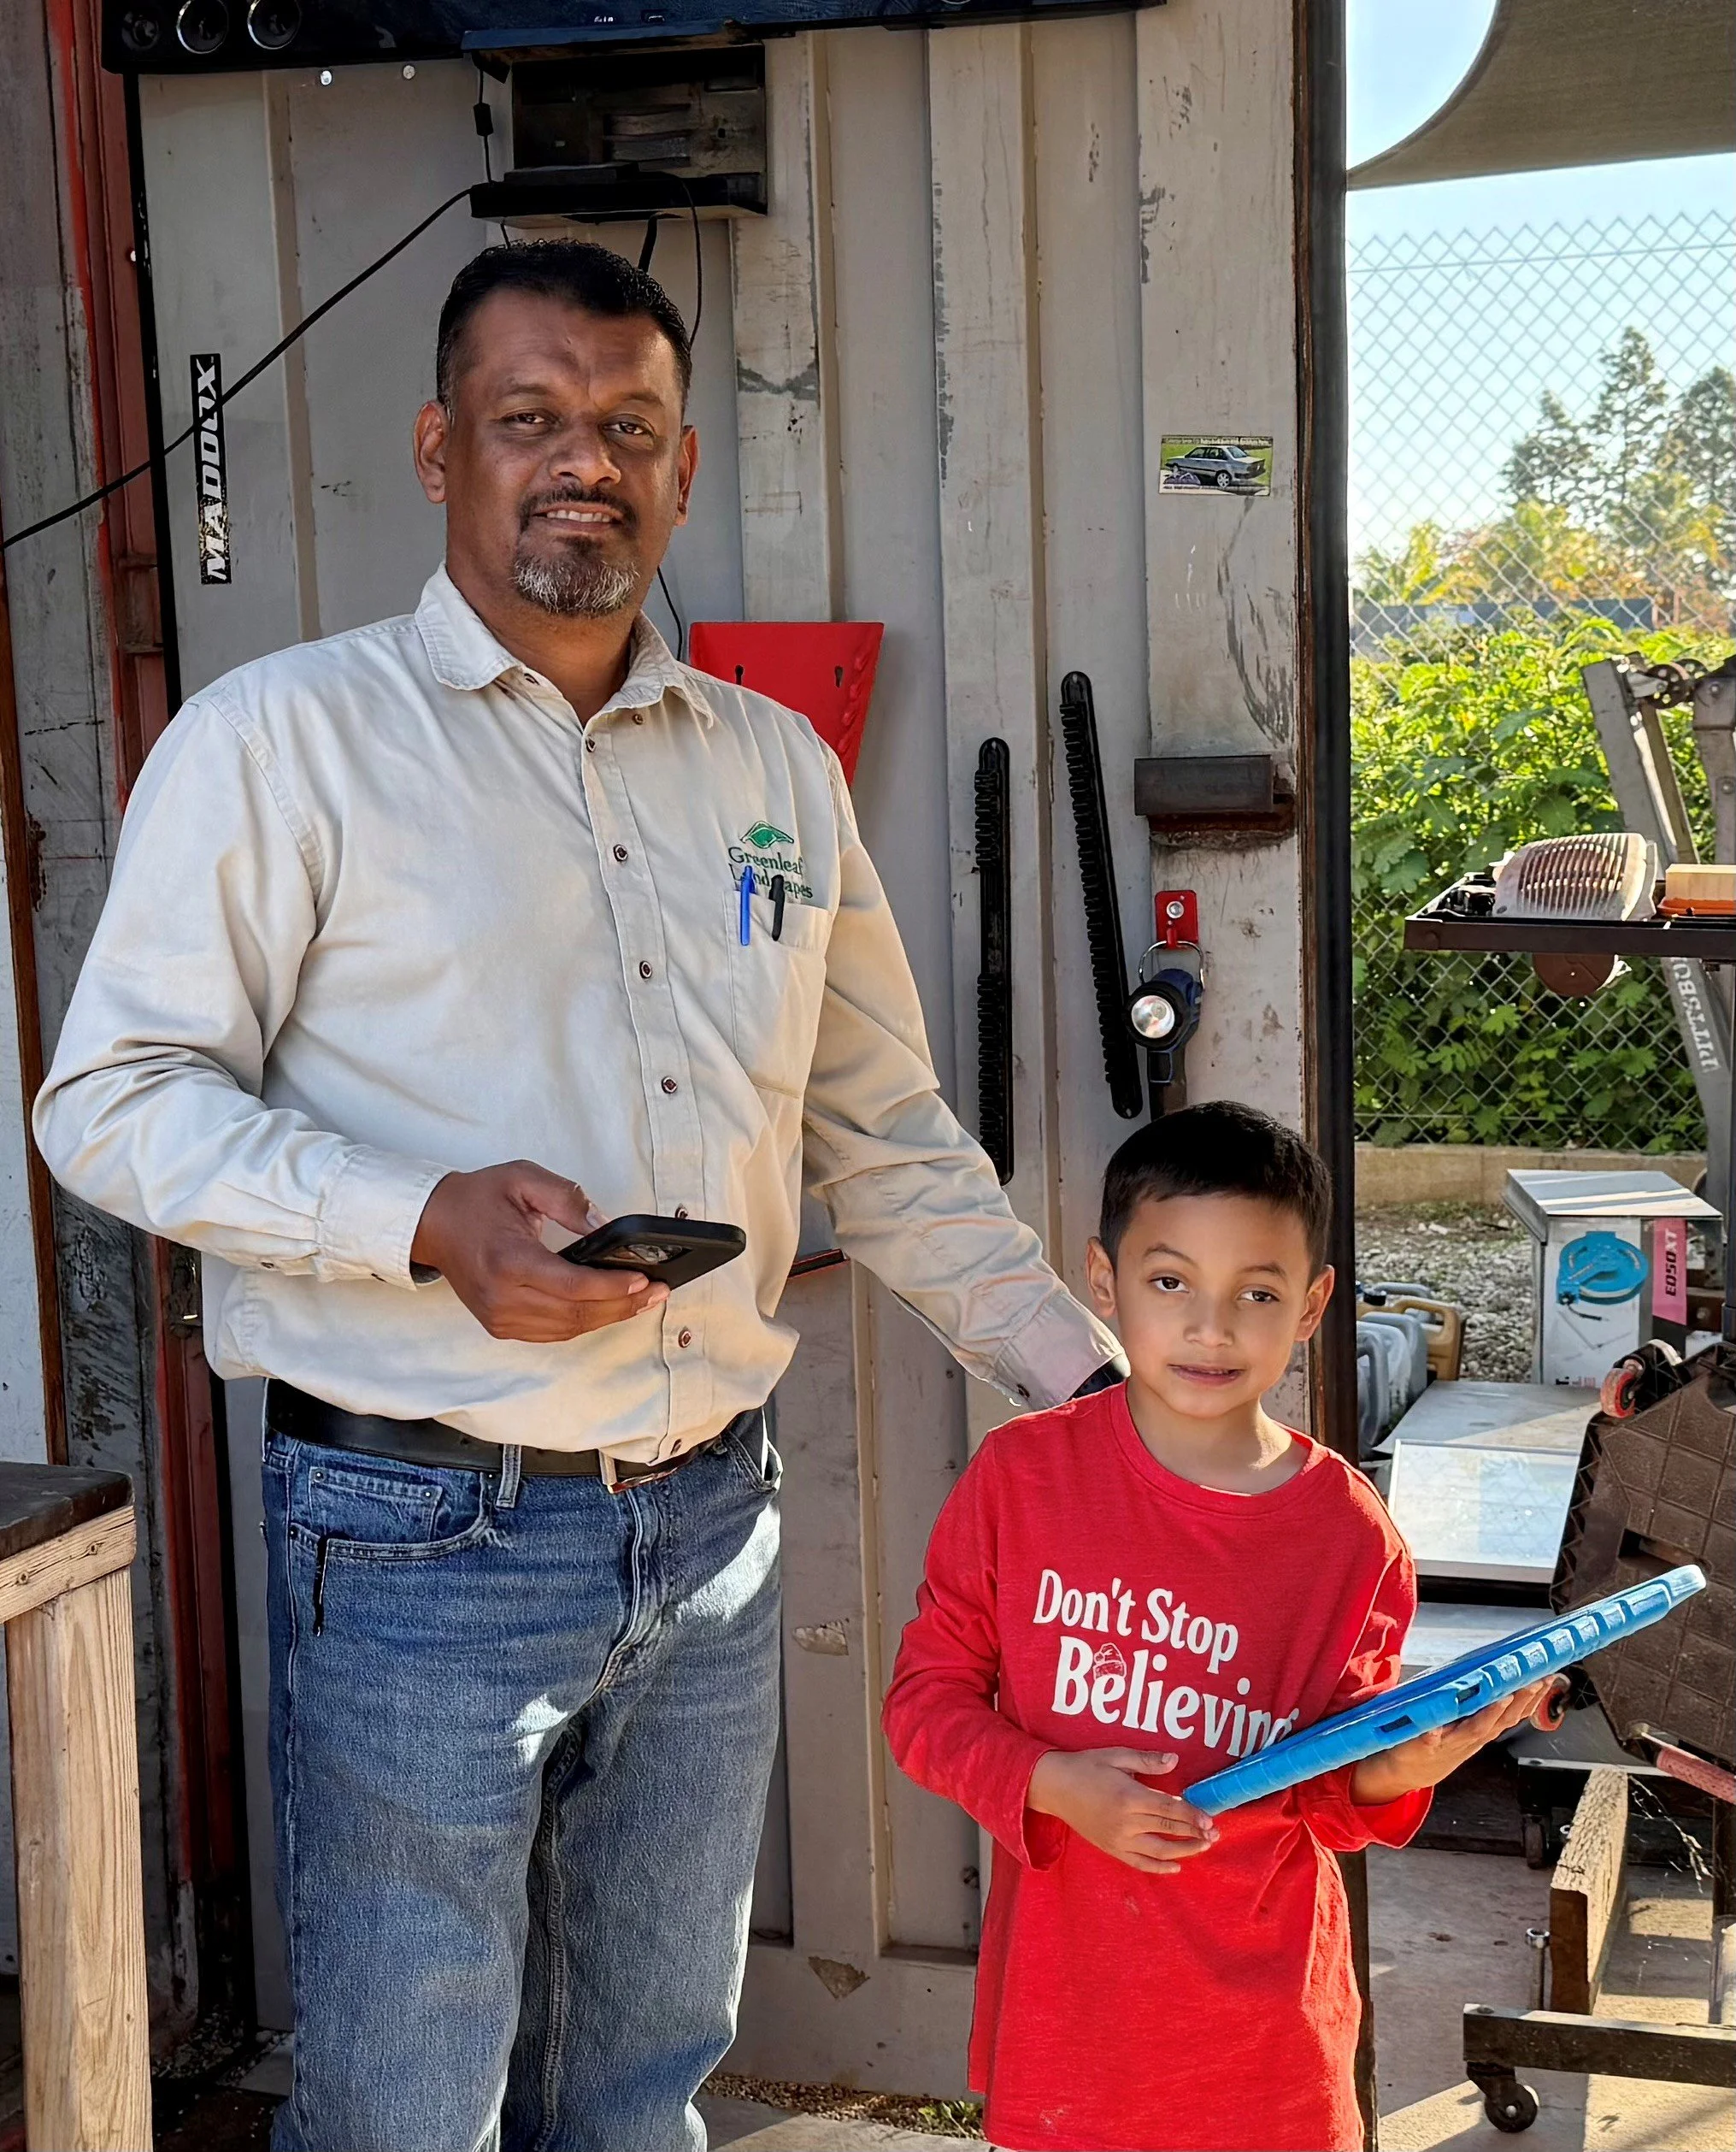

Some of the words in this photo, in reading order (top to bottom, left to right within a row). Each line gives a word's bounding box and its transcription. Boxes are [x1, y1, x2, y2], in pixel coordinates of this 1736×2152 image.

[196, 357, 227, 581] MADDOX
[728, 846, 803, 876] Greenleaf
[728, 864, 813, 899] Lndapes
[1033, 1569, 1136, 1636] Don't
[1142, 1588, 1239, 1674] Stop
